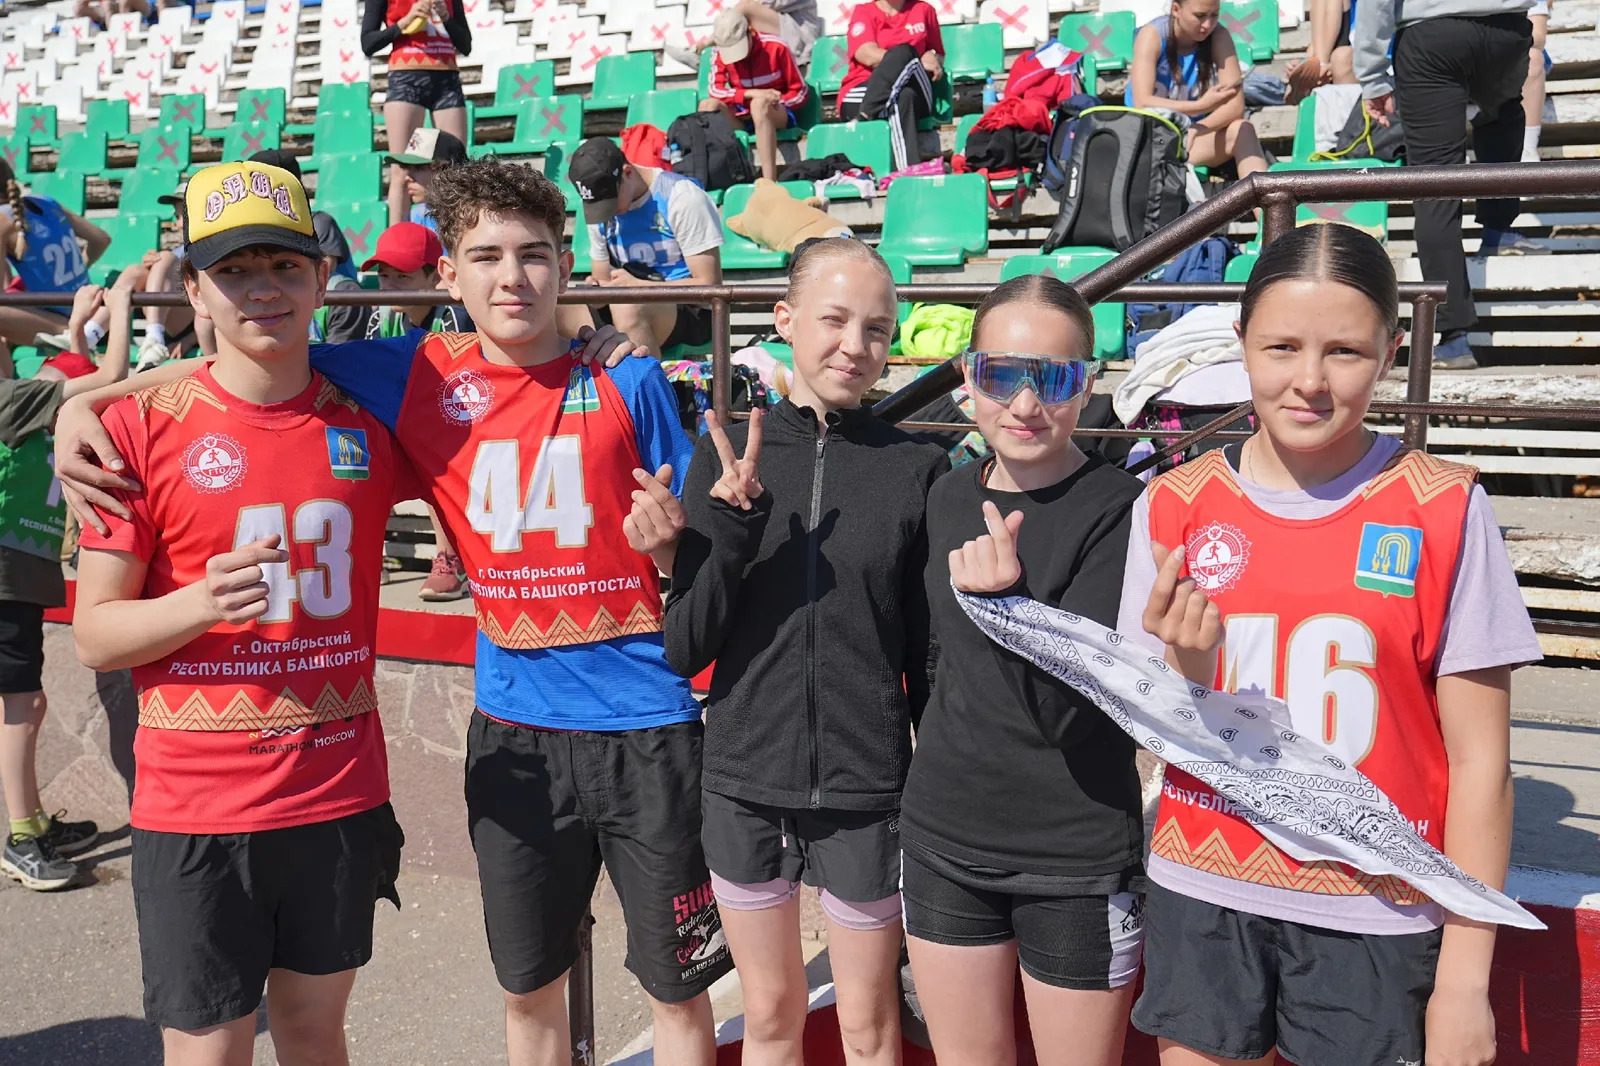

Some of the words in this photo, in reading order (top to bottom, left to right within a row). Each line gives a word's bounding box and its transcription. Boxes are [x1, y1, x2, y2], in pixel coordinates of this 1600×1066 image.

[43, 228, 85, 287] 22
[208, 467, 226, 476] ГТО
[465, 434, 594, 553] 44
[231, 498, 354, 625] 43
[478, 568, 486, 579] г.
[488, 562, 586, 581] Октябрьский
[1206, 565, 1223, 575] ГТО
[521, 576, 641, 600] БАШКОРТОСТАН
[233, 644, 246, 655] г.
[251, 631, 352, 654] Октябрьский
[169, 660, 282, 676] РЕСПУБЛИКА
[249, 738, 314, 755] MARATHON
[315, 729, 356, 748] MOSCOW
